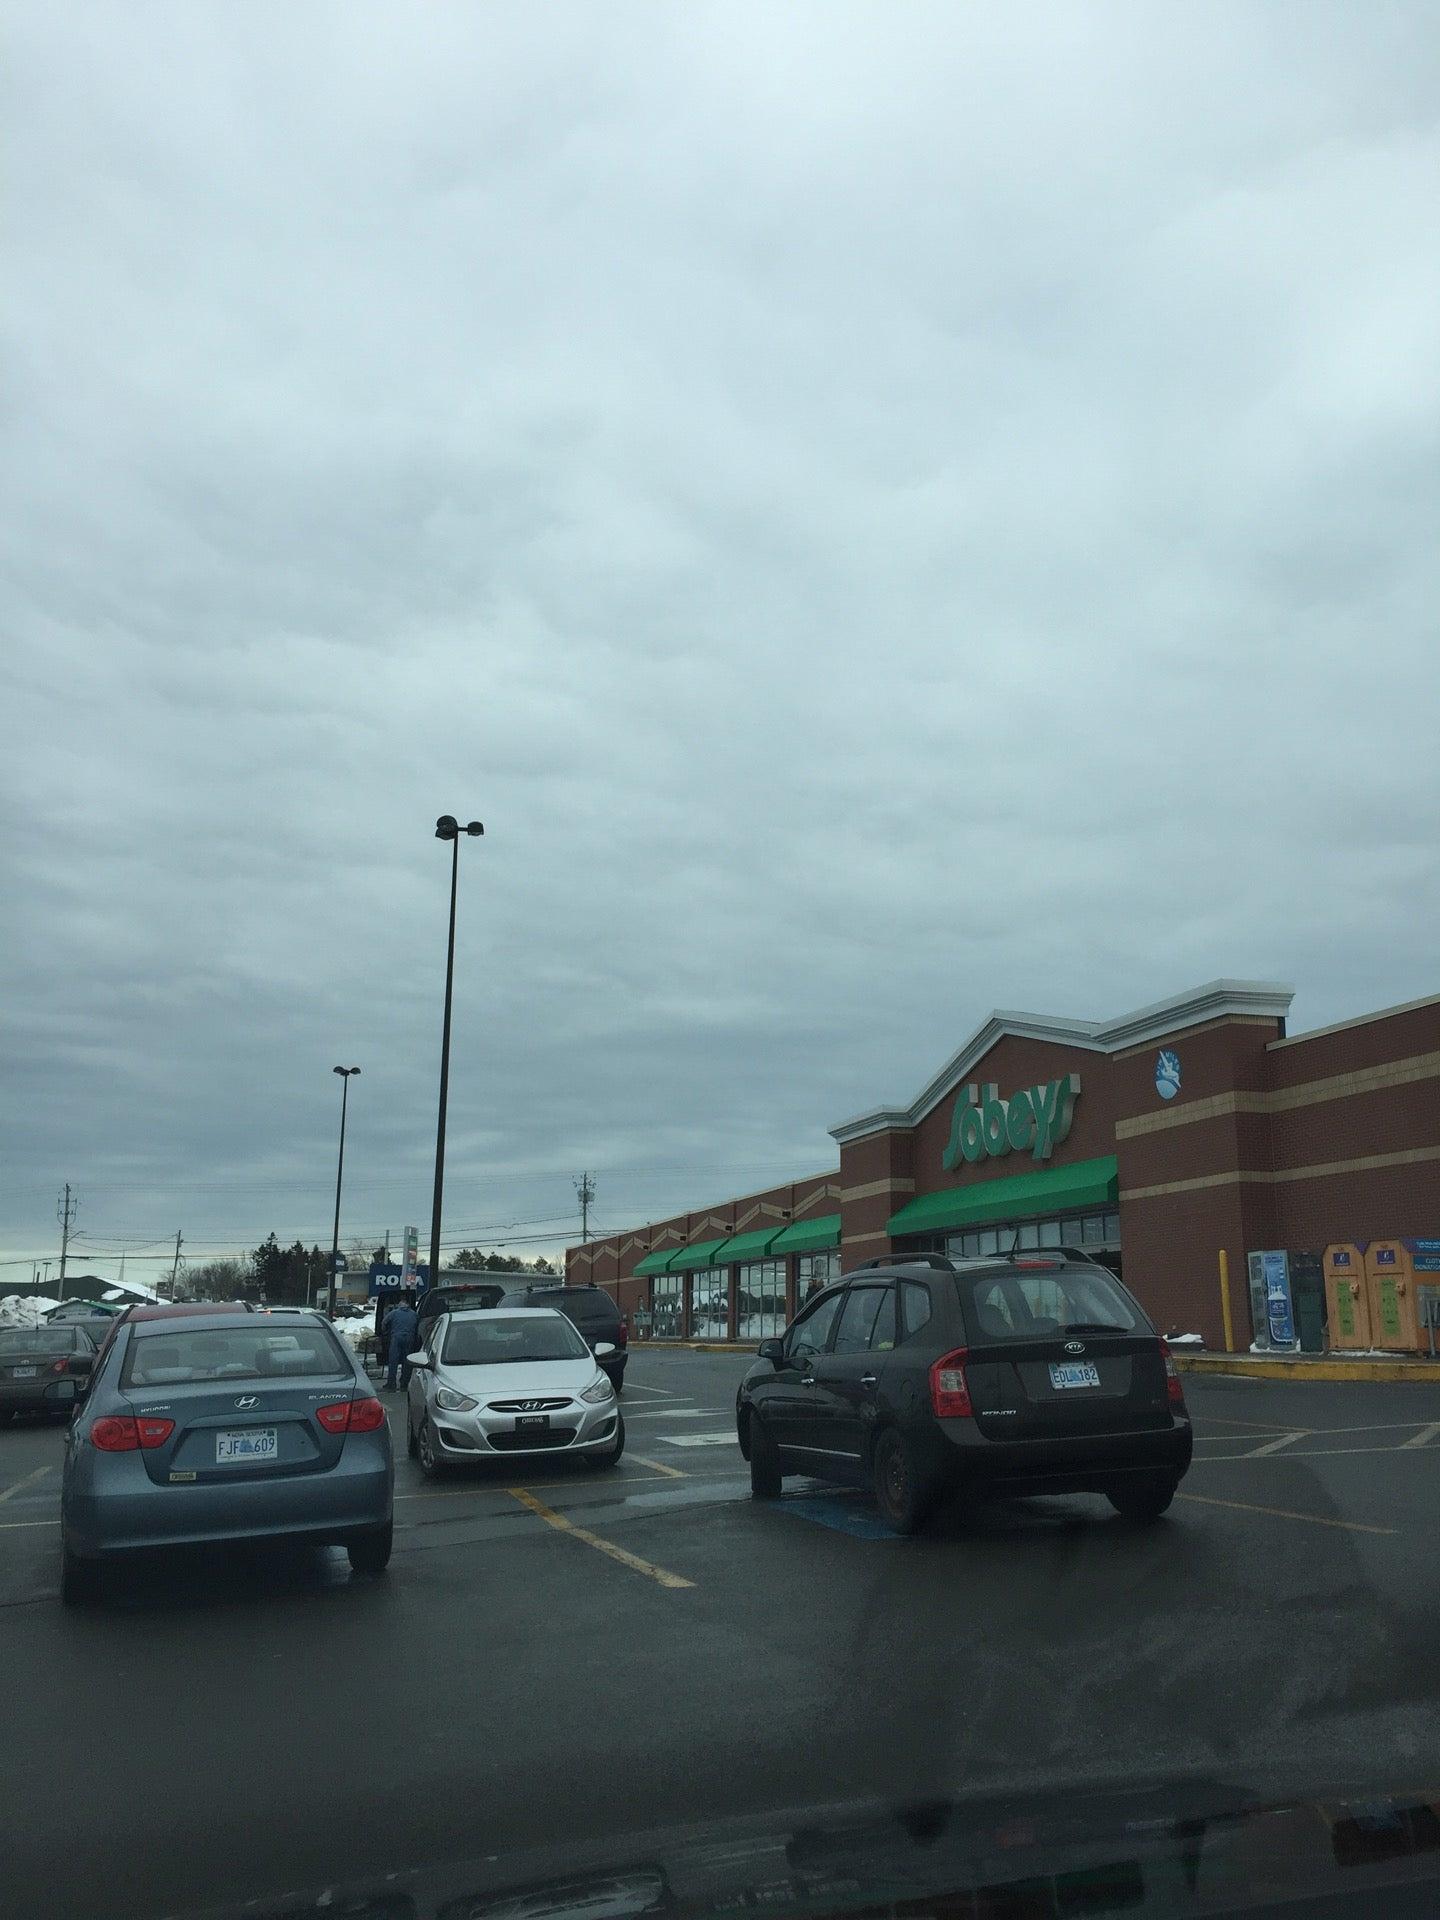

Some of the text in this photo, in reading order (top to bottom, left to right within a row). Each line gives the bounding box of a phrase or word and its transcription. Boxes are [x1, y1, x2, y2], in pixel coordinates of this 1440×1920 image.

[943, 1073, 1081, 1170] Sobeys
[375, 1274, 424, 1286] ROA
[1052, 1368, 1098, 1383] EDL 182
[308, 1393, 348, 1401] ELANTRA
[218, 1440, 240, 1456] FJF
[254, 1437, 275, 1453] 609
